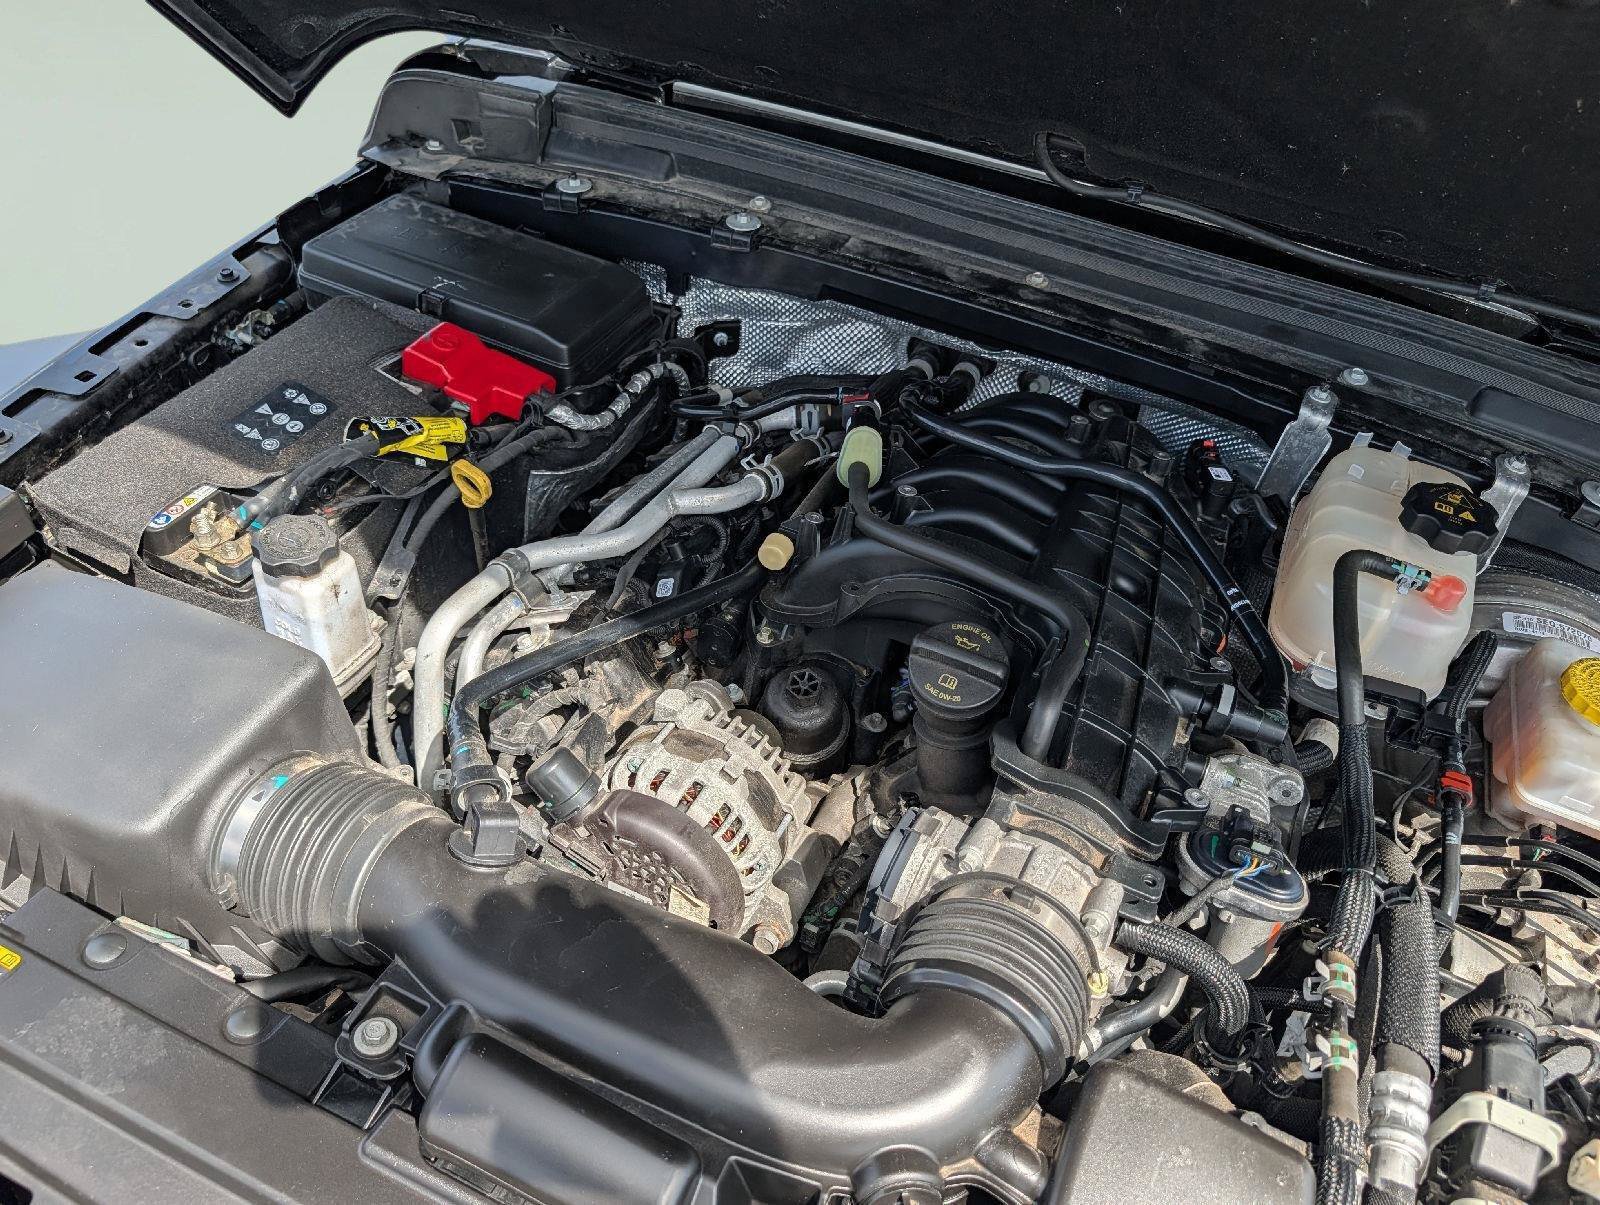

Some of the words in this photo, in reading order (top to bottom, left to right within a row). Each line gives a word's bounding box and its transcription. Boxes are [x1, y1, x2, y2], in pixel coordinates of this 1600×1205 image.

[951, 623, 982, 635] ENGINE
[981, 632, 992, 644] OIL
[924, 682, 940, 697] SAE
[938, 693, 961, 702] 0W-20
